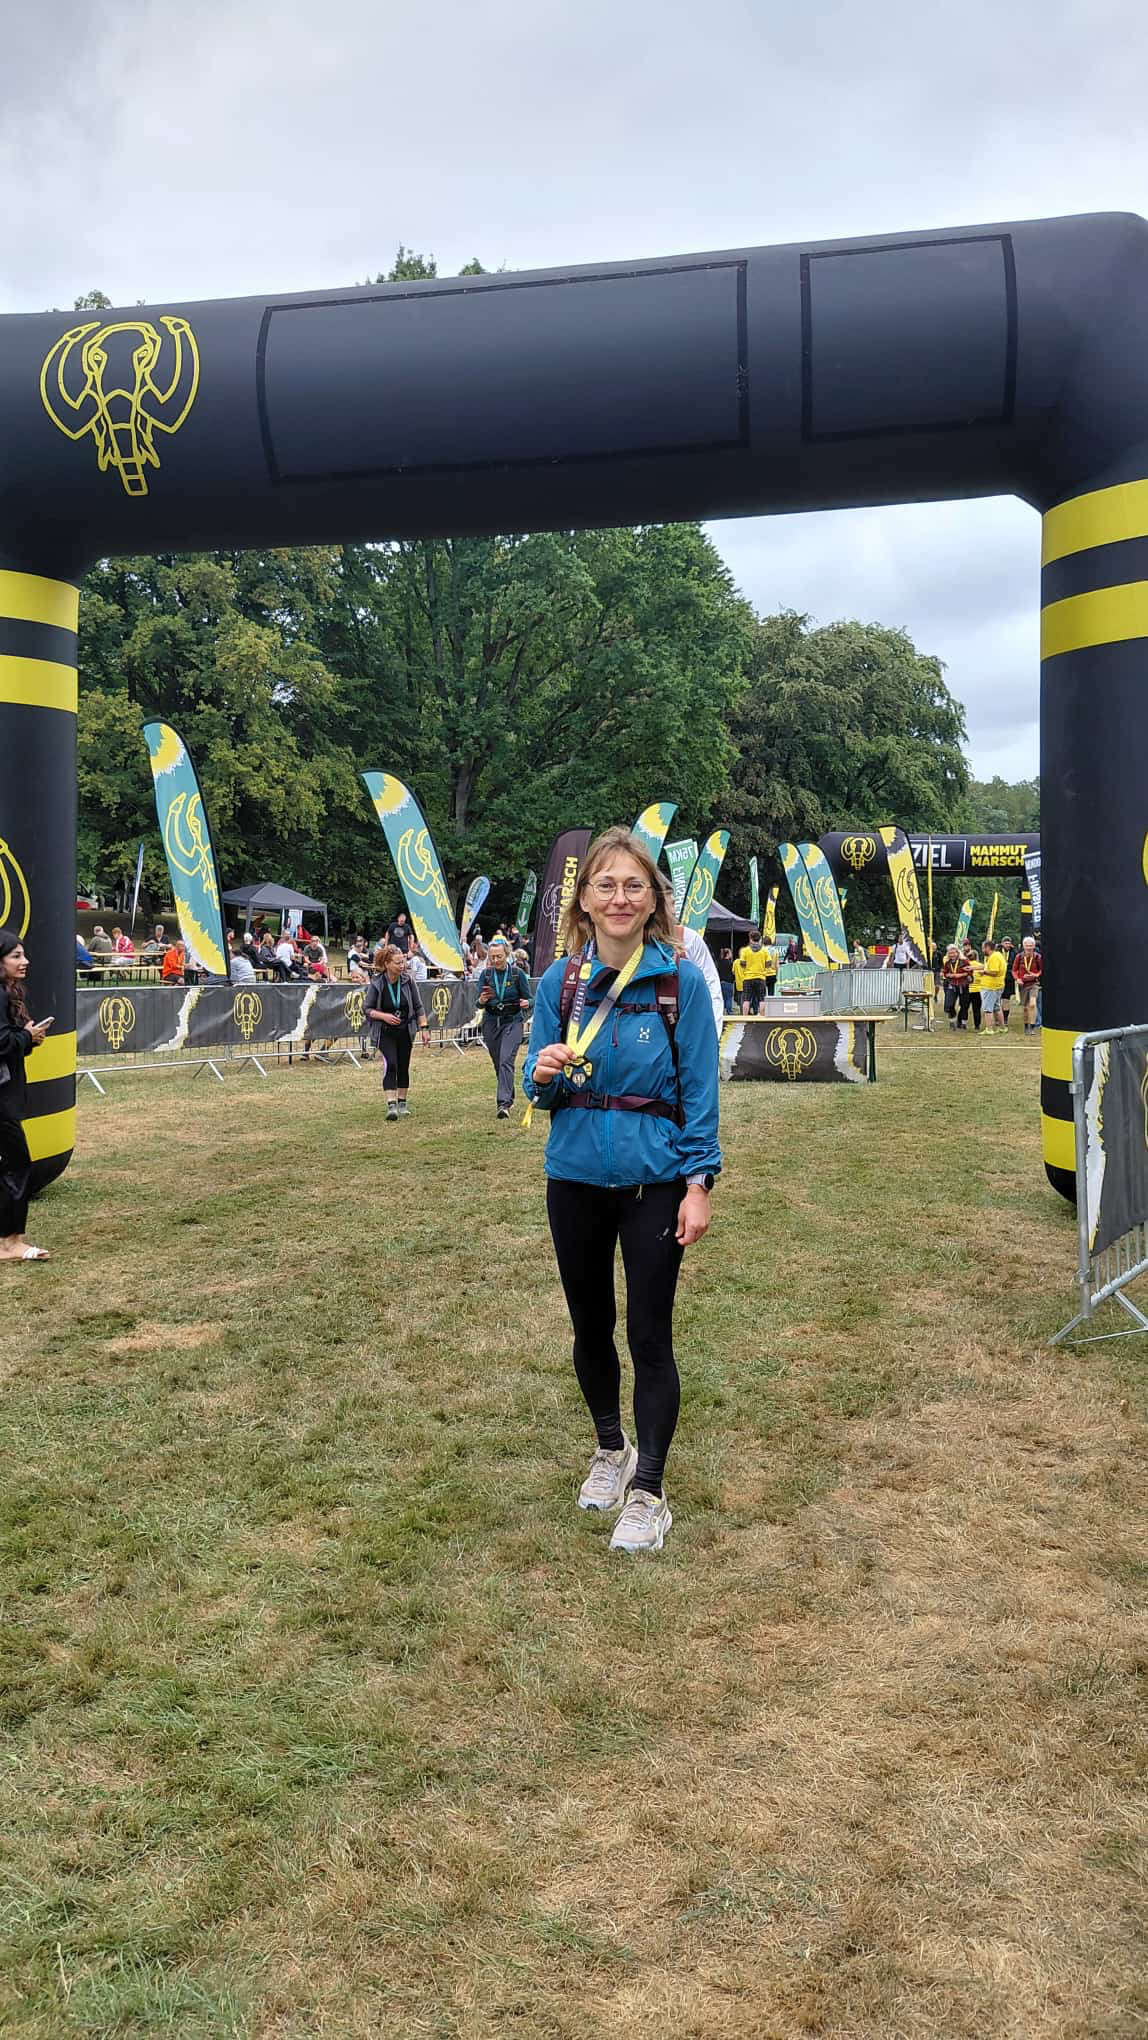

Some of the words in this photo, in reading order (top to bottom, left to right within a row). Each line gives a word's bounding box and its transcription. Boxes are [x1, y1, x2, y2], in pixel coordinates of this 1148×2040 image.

[910, 844, 951, 867] ZIEL
[970, 845, 1027, 856] MAMMUT
[971, 856, 1024, 867] MARSCH
